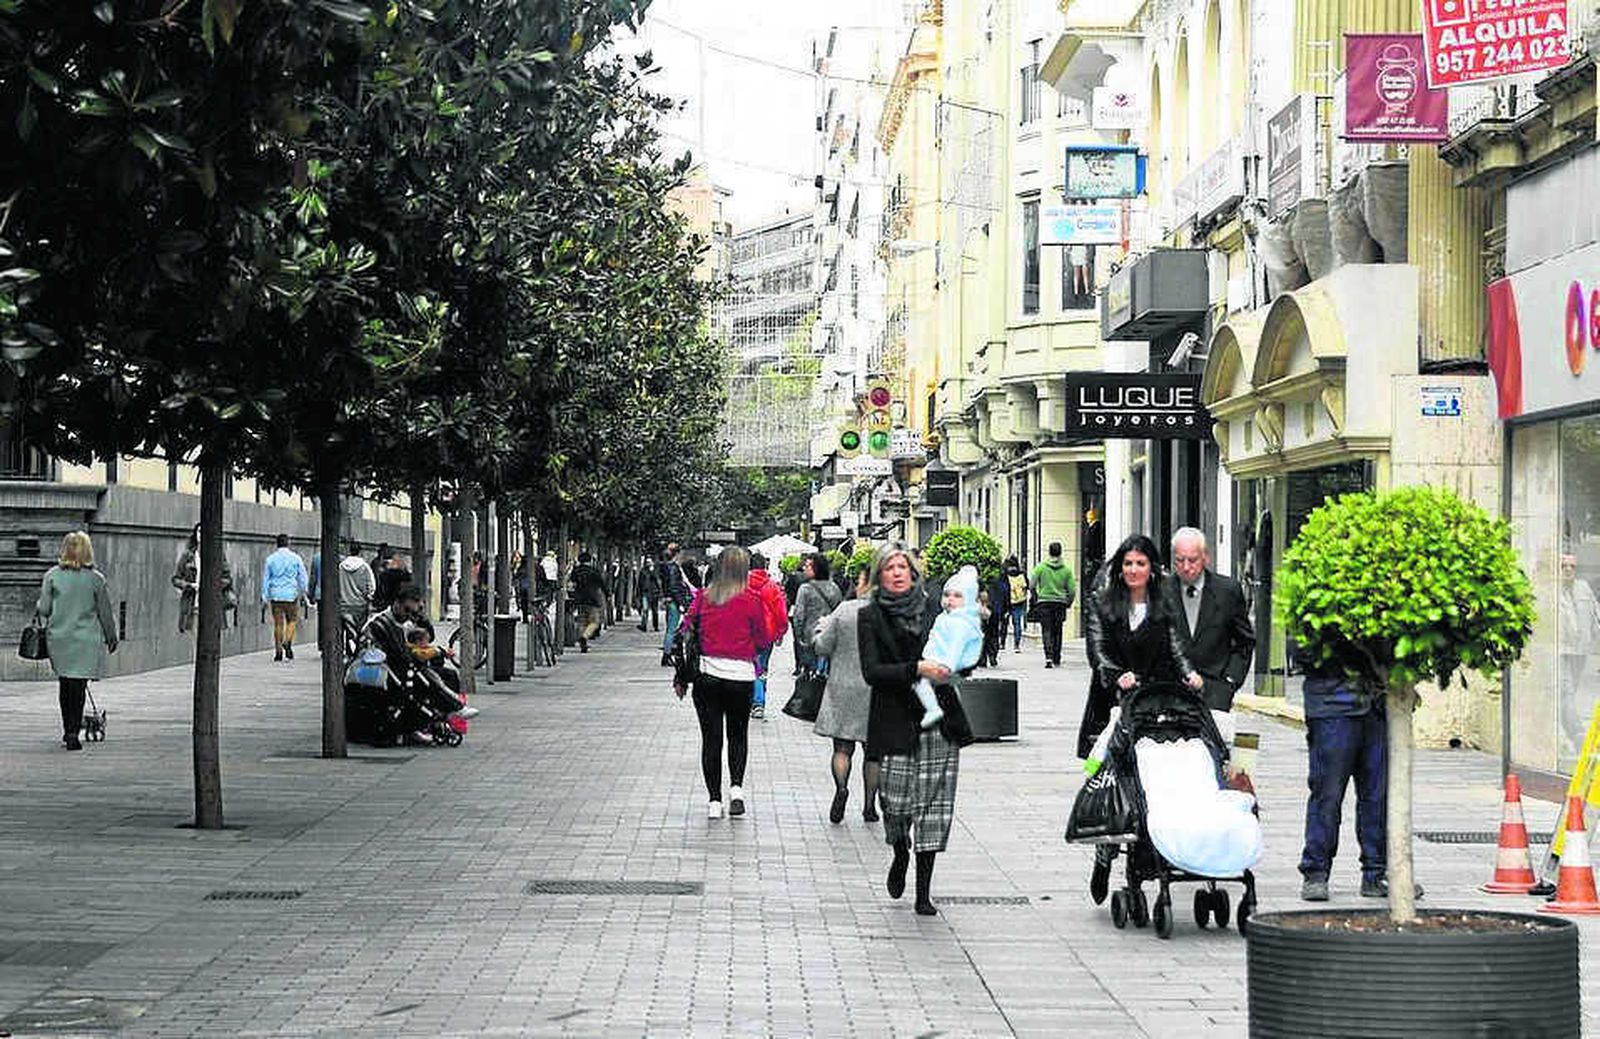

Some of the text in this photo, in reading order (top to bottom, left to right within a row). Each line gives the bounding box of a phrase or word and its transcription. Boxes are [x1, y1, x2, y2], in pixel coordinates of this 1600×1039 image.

[1438, 13, 1566, 49] ALQUILA
[1436, 48, 1476, 74] 957
[1482, 41, 1525, 67] 244
[1080, 387, 1194, 407] LUQUE
[1080, 413, 1194, 427] joyeros
